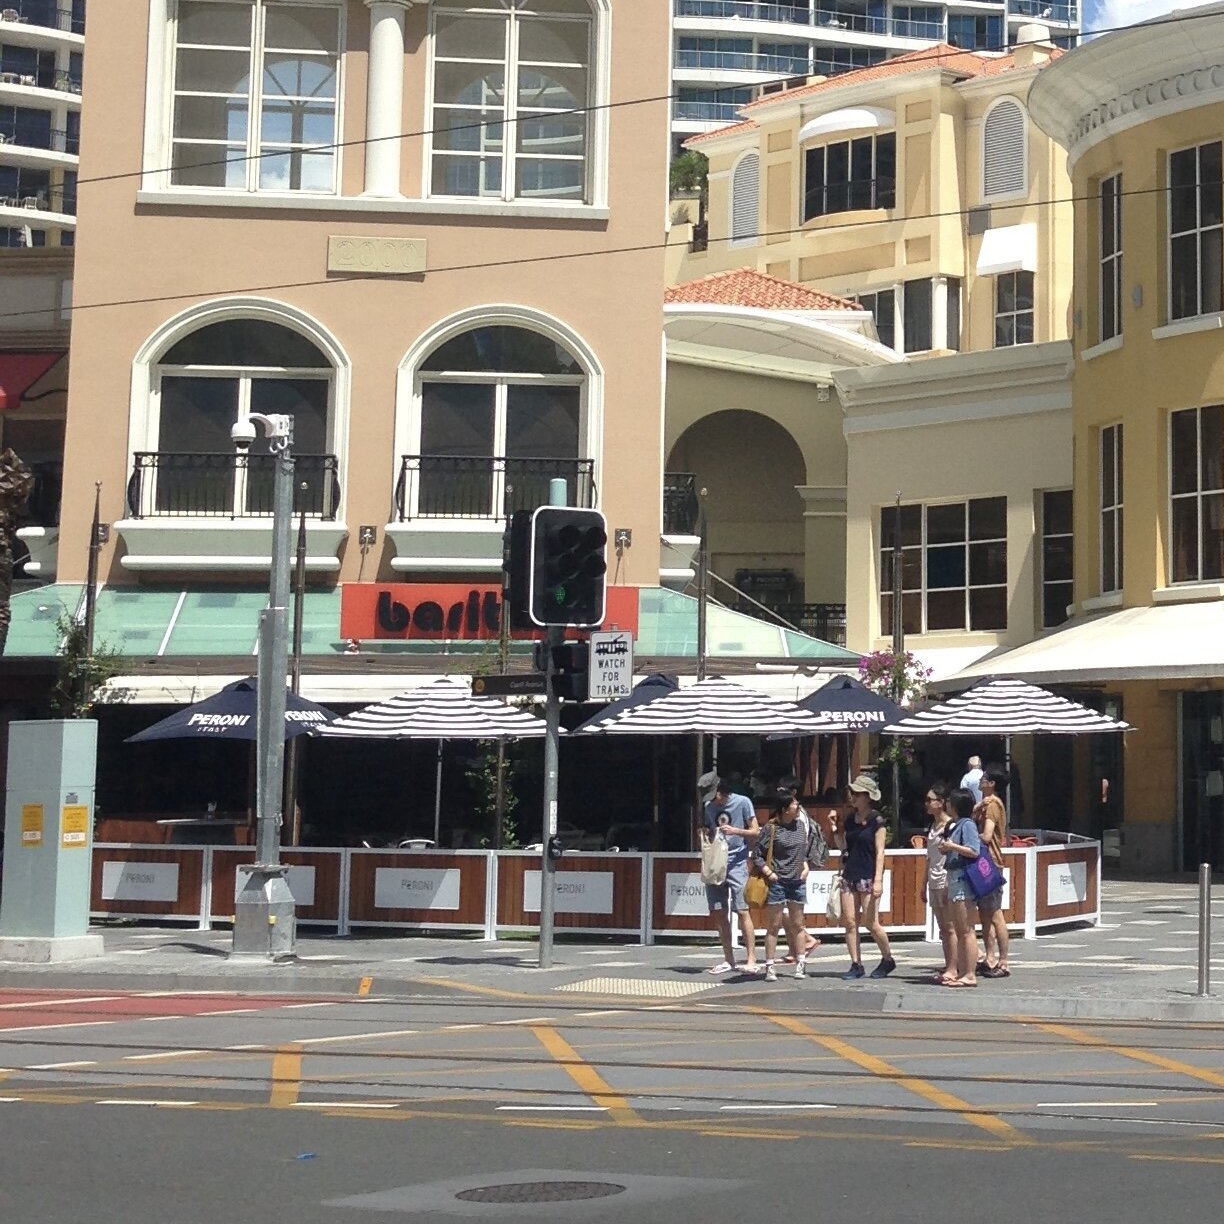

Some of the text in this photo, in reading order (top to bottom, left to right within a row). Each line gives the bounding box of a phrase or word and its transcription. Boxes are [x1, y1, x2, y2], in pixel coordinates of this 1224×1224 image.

[337, 241, 418, 267] 2000
[598, 659, 626, 668] WATCH
[602, 672, 619, 681] FOR
[597, 685, 625, 695] TRAMS
[188, 713, 250, 726] PERONI
[820, 710, 886, 722] PERONI
[401, 879, 433, 891] PERONI
[554, 883, 585, 894] ERONI
[670, 884, 706, 897] PERONI
